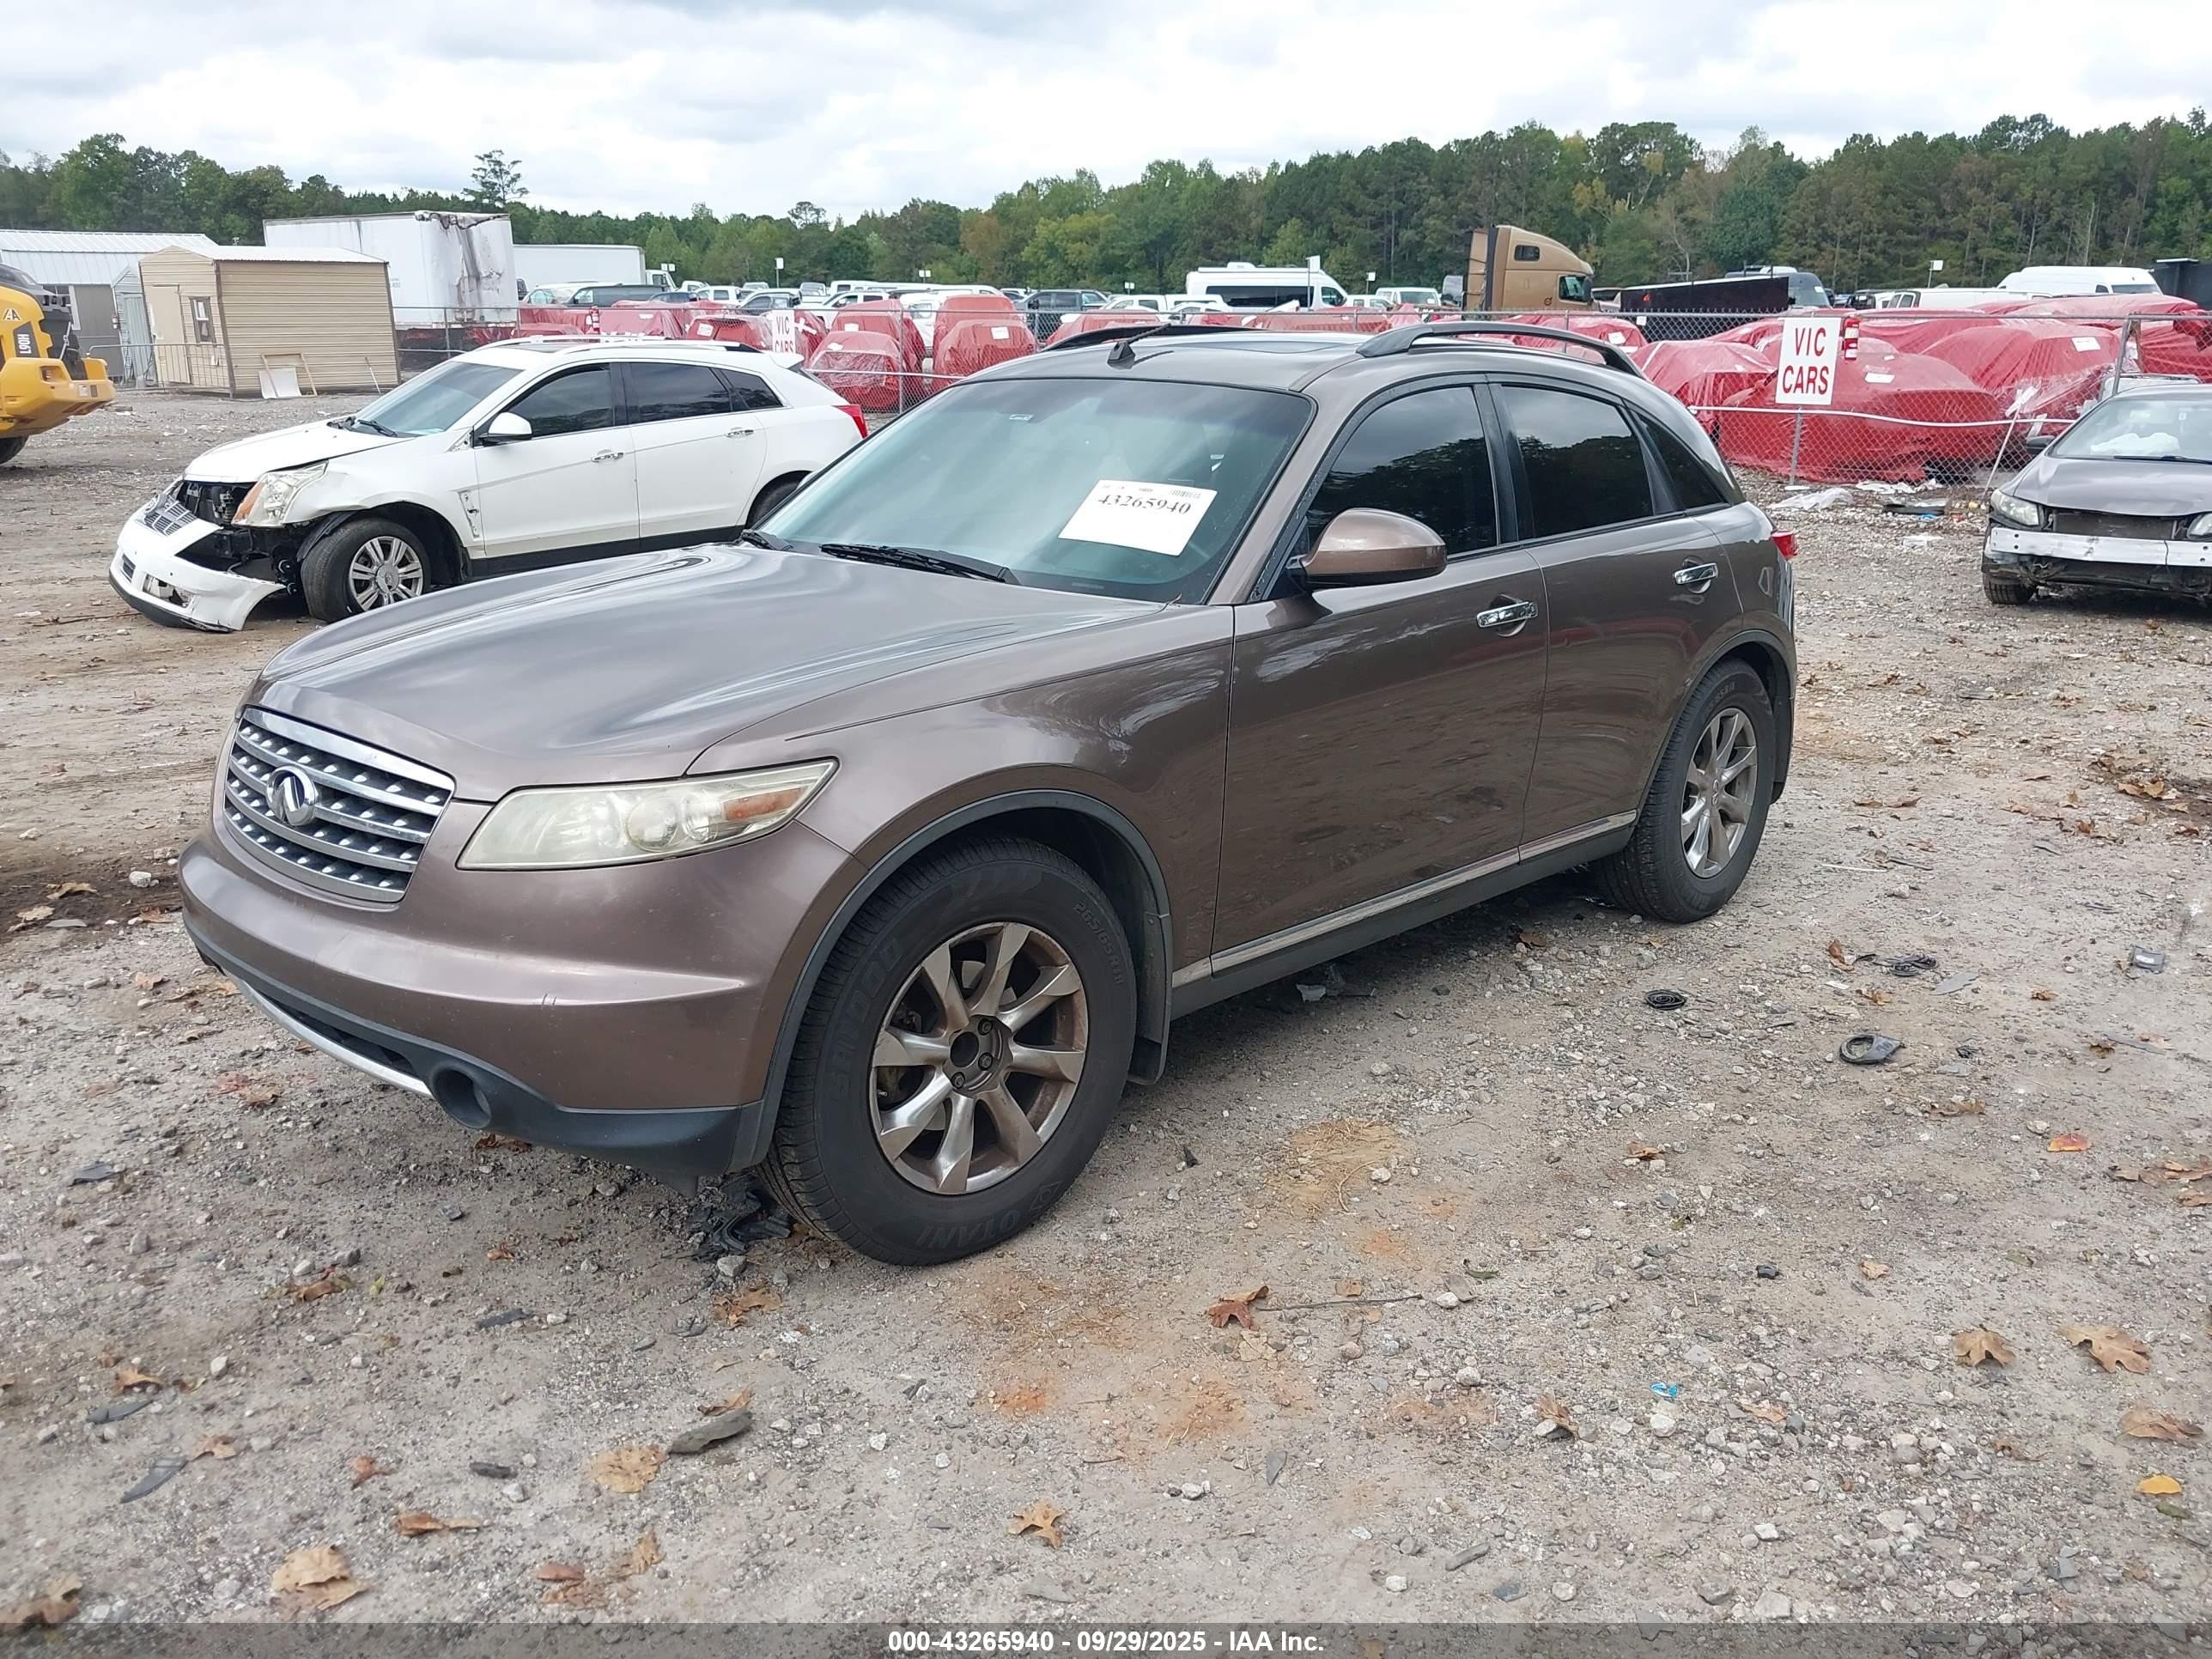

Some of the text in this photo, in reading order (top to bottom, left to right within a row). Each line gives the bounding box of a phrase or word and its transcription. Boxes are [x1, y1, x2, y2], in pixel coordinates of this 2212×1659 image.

[775, 315, 791, 335] VIC
[17, 333, 33, 354] L90H
[1795, 327, 1826, 357] VIC
[1782, 364, 1830, 395] CARS
[1097, 494, 1192, 515] 43265940
